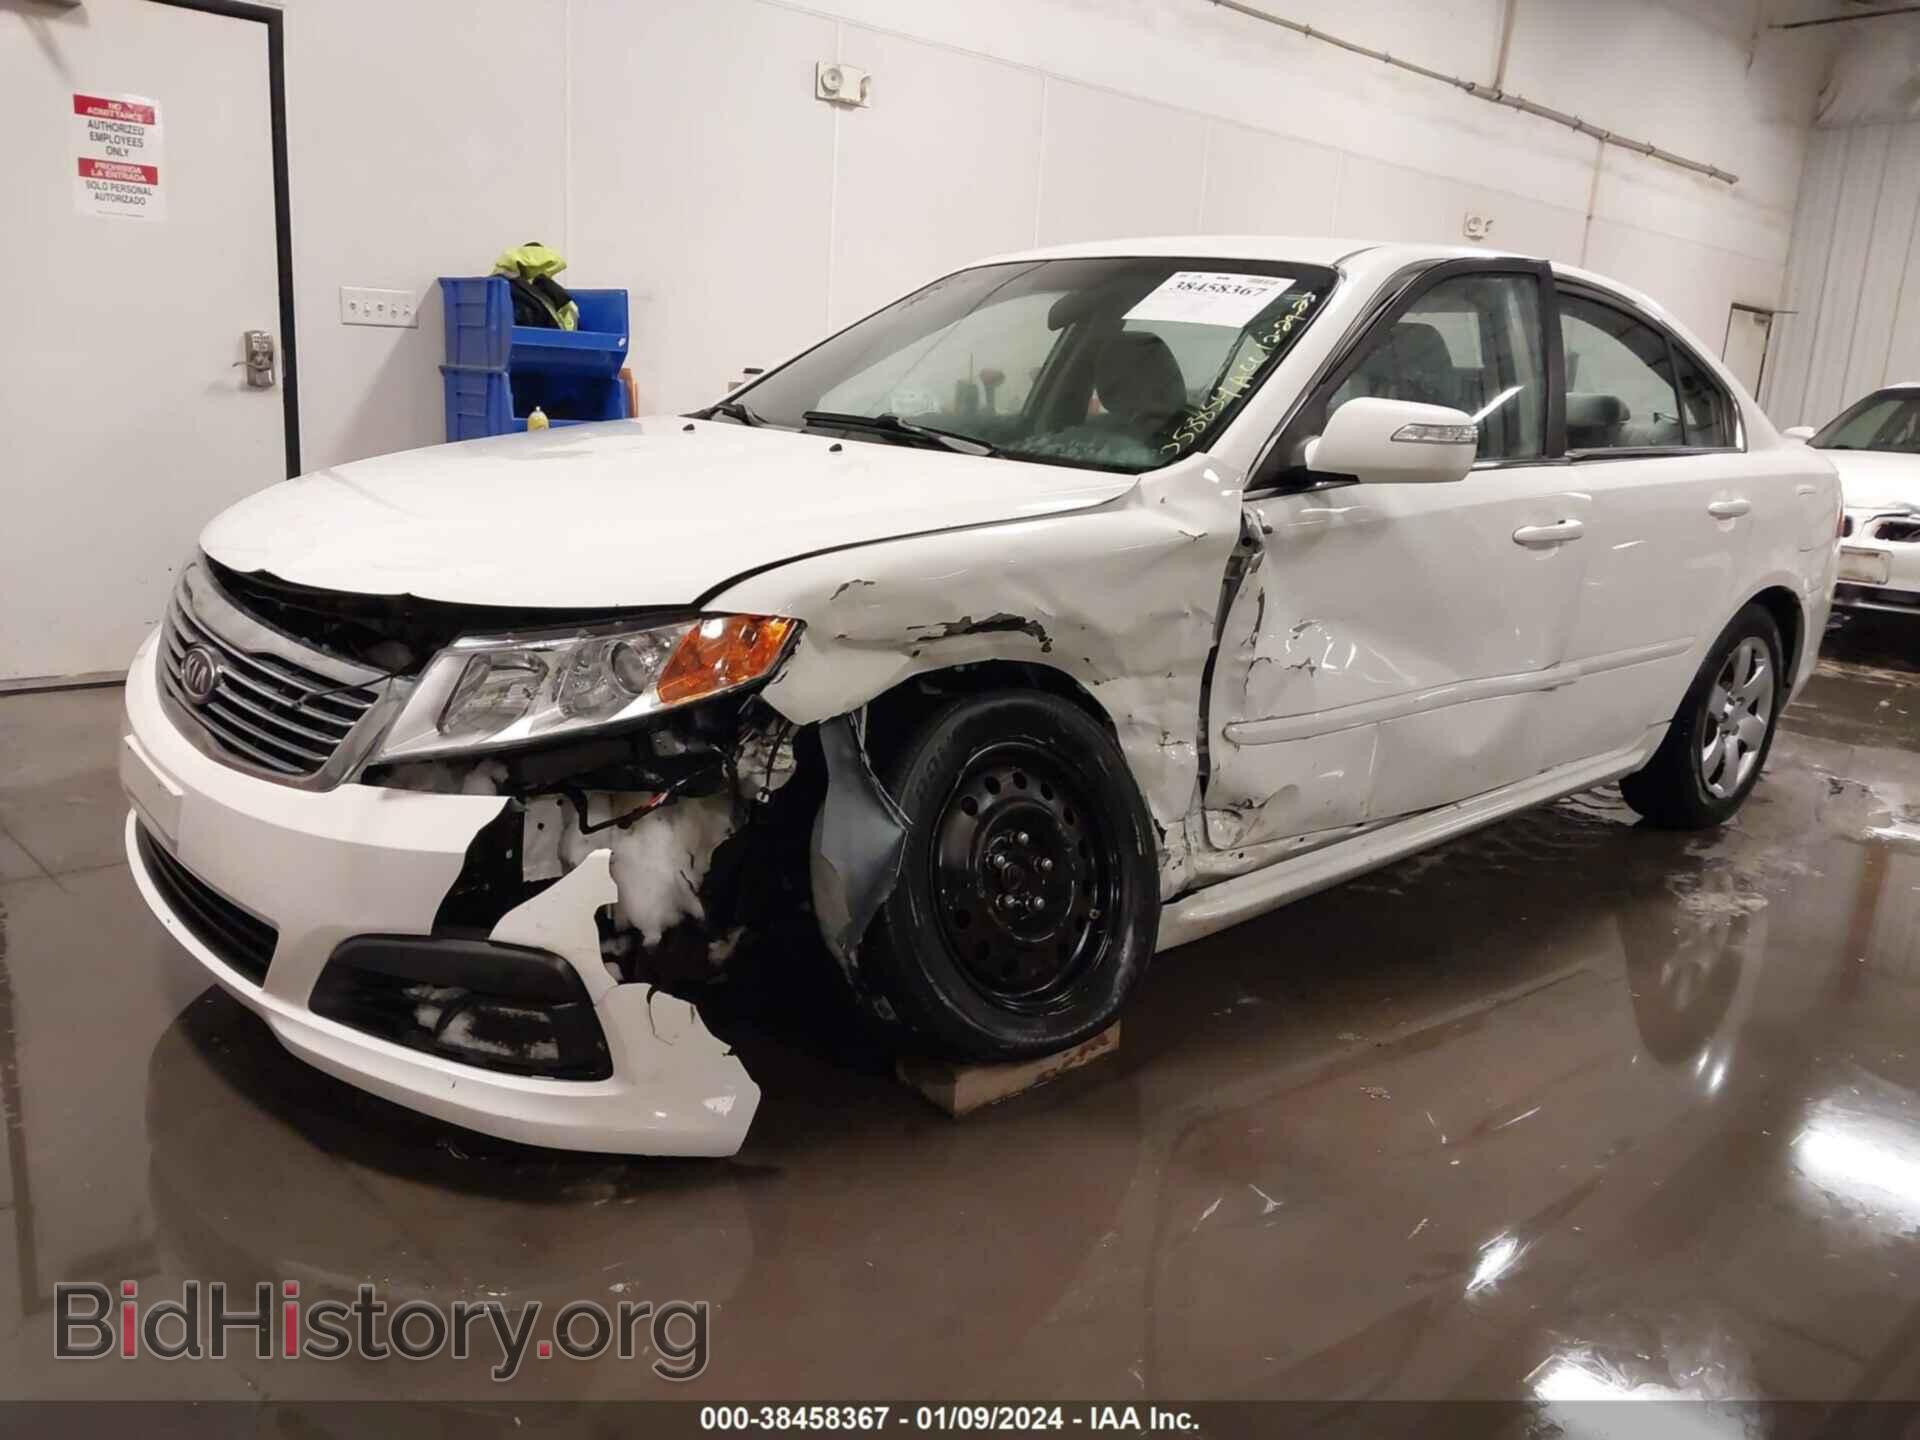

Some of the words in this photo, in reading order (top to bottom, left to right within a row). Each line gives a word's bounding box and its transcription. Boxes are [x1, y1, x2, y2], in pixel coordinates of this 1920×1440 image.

[87, 120, 144, 136] AUTHORIZED
[89, 131, 144, 148] EMPLOYEES
[105, 145, 129, 157] ONLY
[86, 180, 108, 191] SOLO
[110, 182, 153, 196] PERSONAL
[94, 192, 146, 206] AUTORIZADO
[1171, 281, 1267, 296] 38458367
[185, 654, 208, 693] KIA
